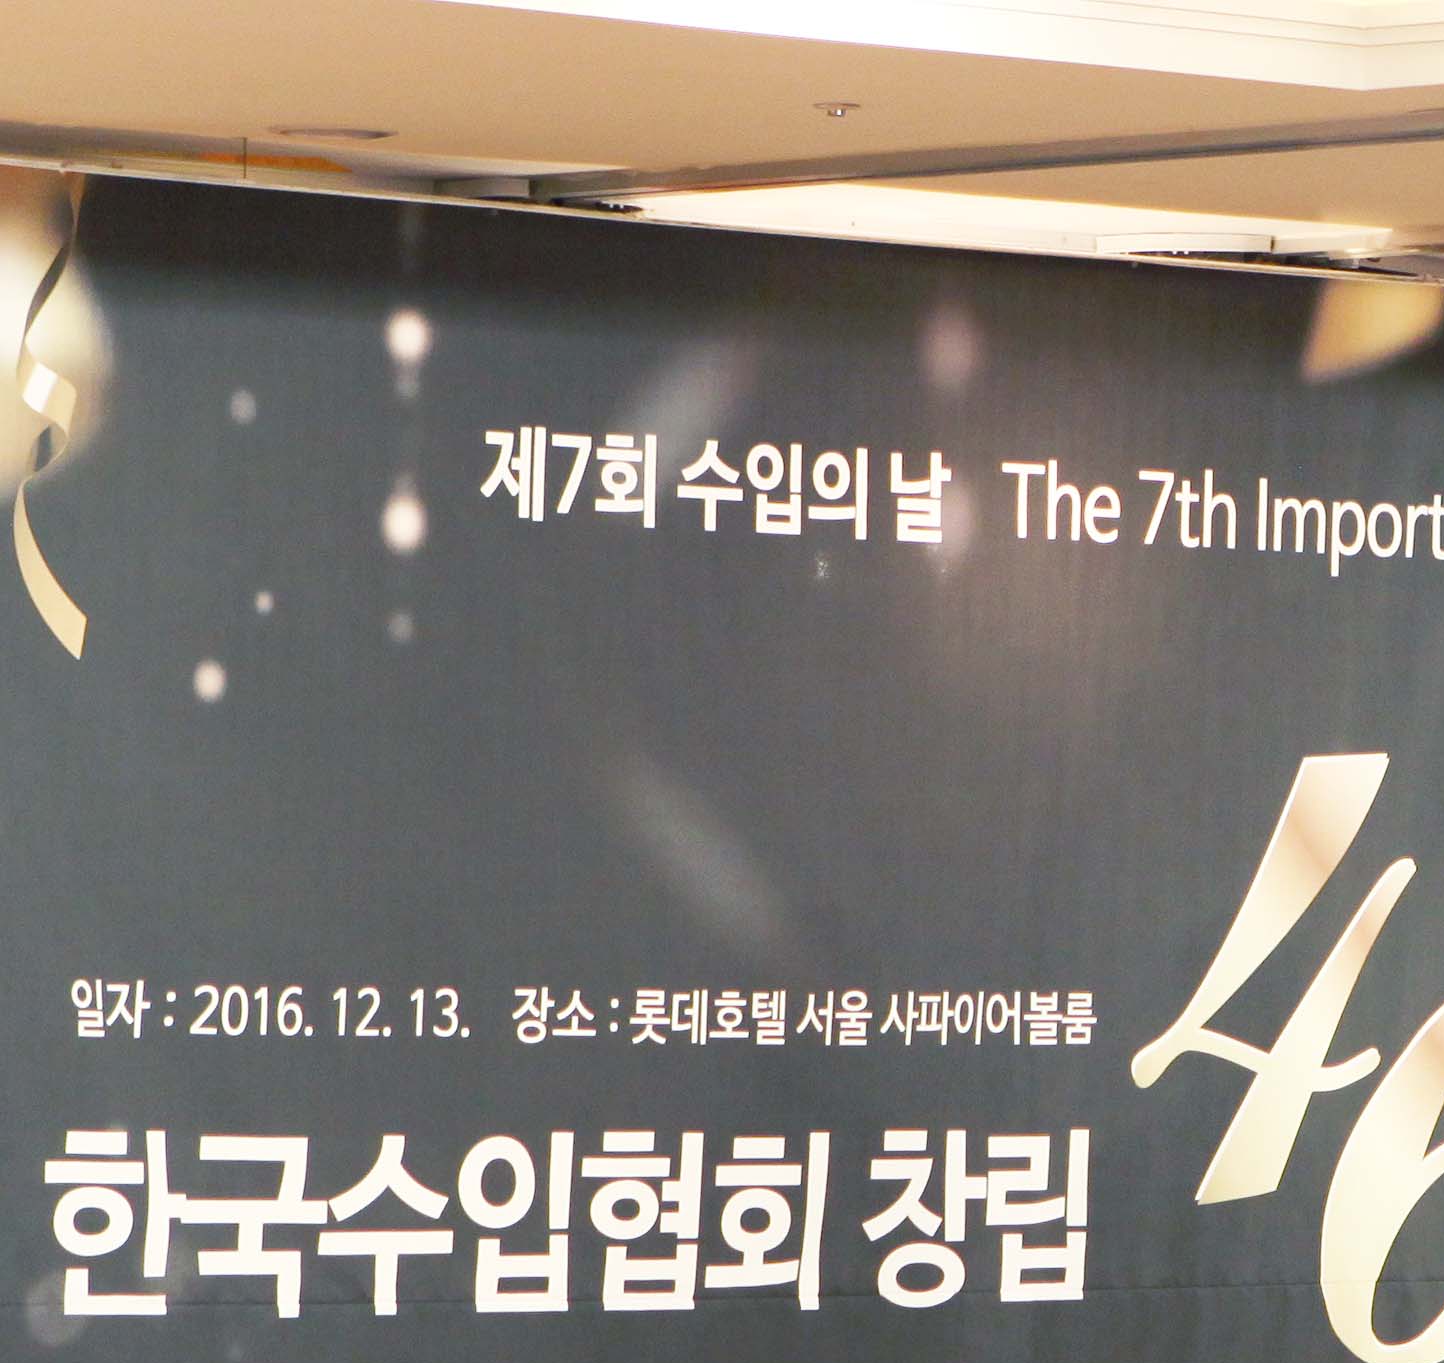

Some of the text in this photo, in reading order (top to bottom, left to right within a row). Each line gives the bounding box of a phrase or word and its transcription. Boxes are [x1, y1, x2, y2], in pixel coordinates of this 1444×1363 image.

[479, 426, 951, 544] 제7회 수입의 날
[1001, 459, 1121, 544] The
[1138, 468, 1237, 550] 7th
[189, 984, 314, 1037] 2016.
[332, 987, 393, 1038] 12.
[410, 987, 471, 1038] 13.
[629, 989, 786, 1046] 롯데호텔
[796, 990, 873, 1046] 서울
[879, 990, 1098, 1046] 사파이어볼룸
[44, 1129, 831, 1319] 한국수입협회
[861, 1128, 1091, 1309] 창립
